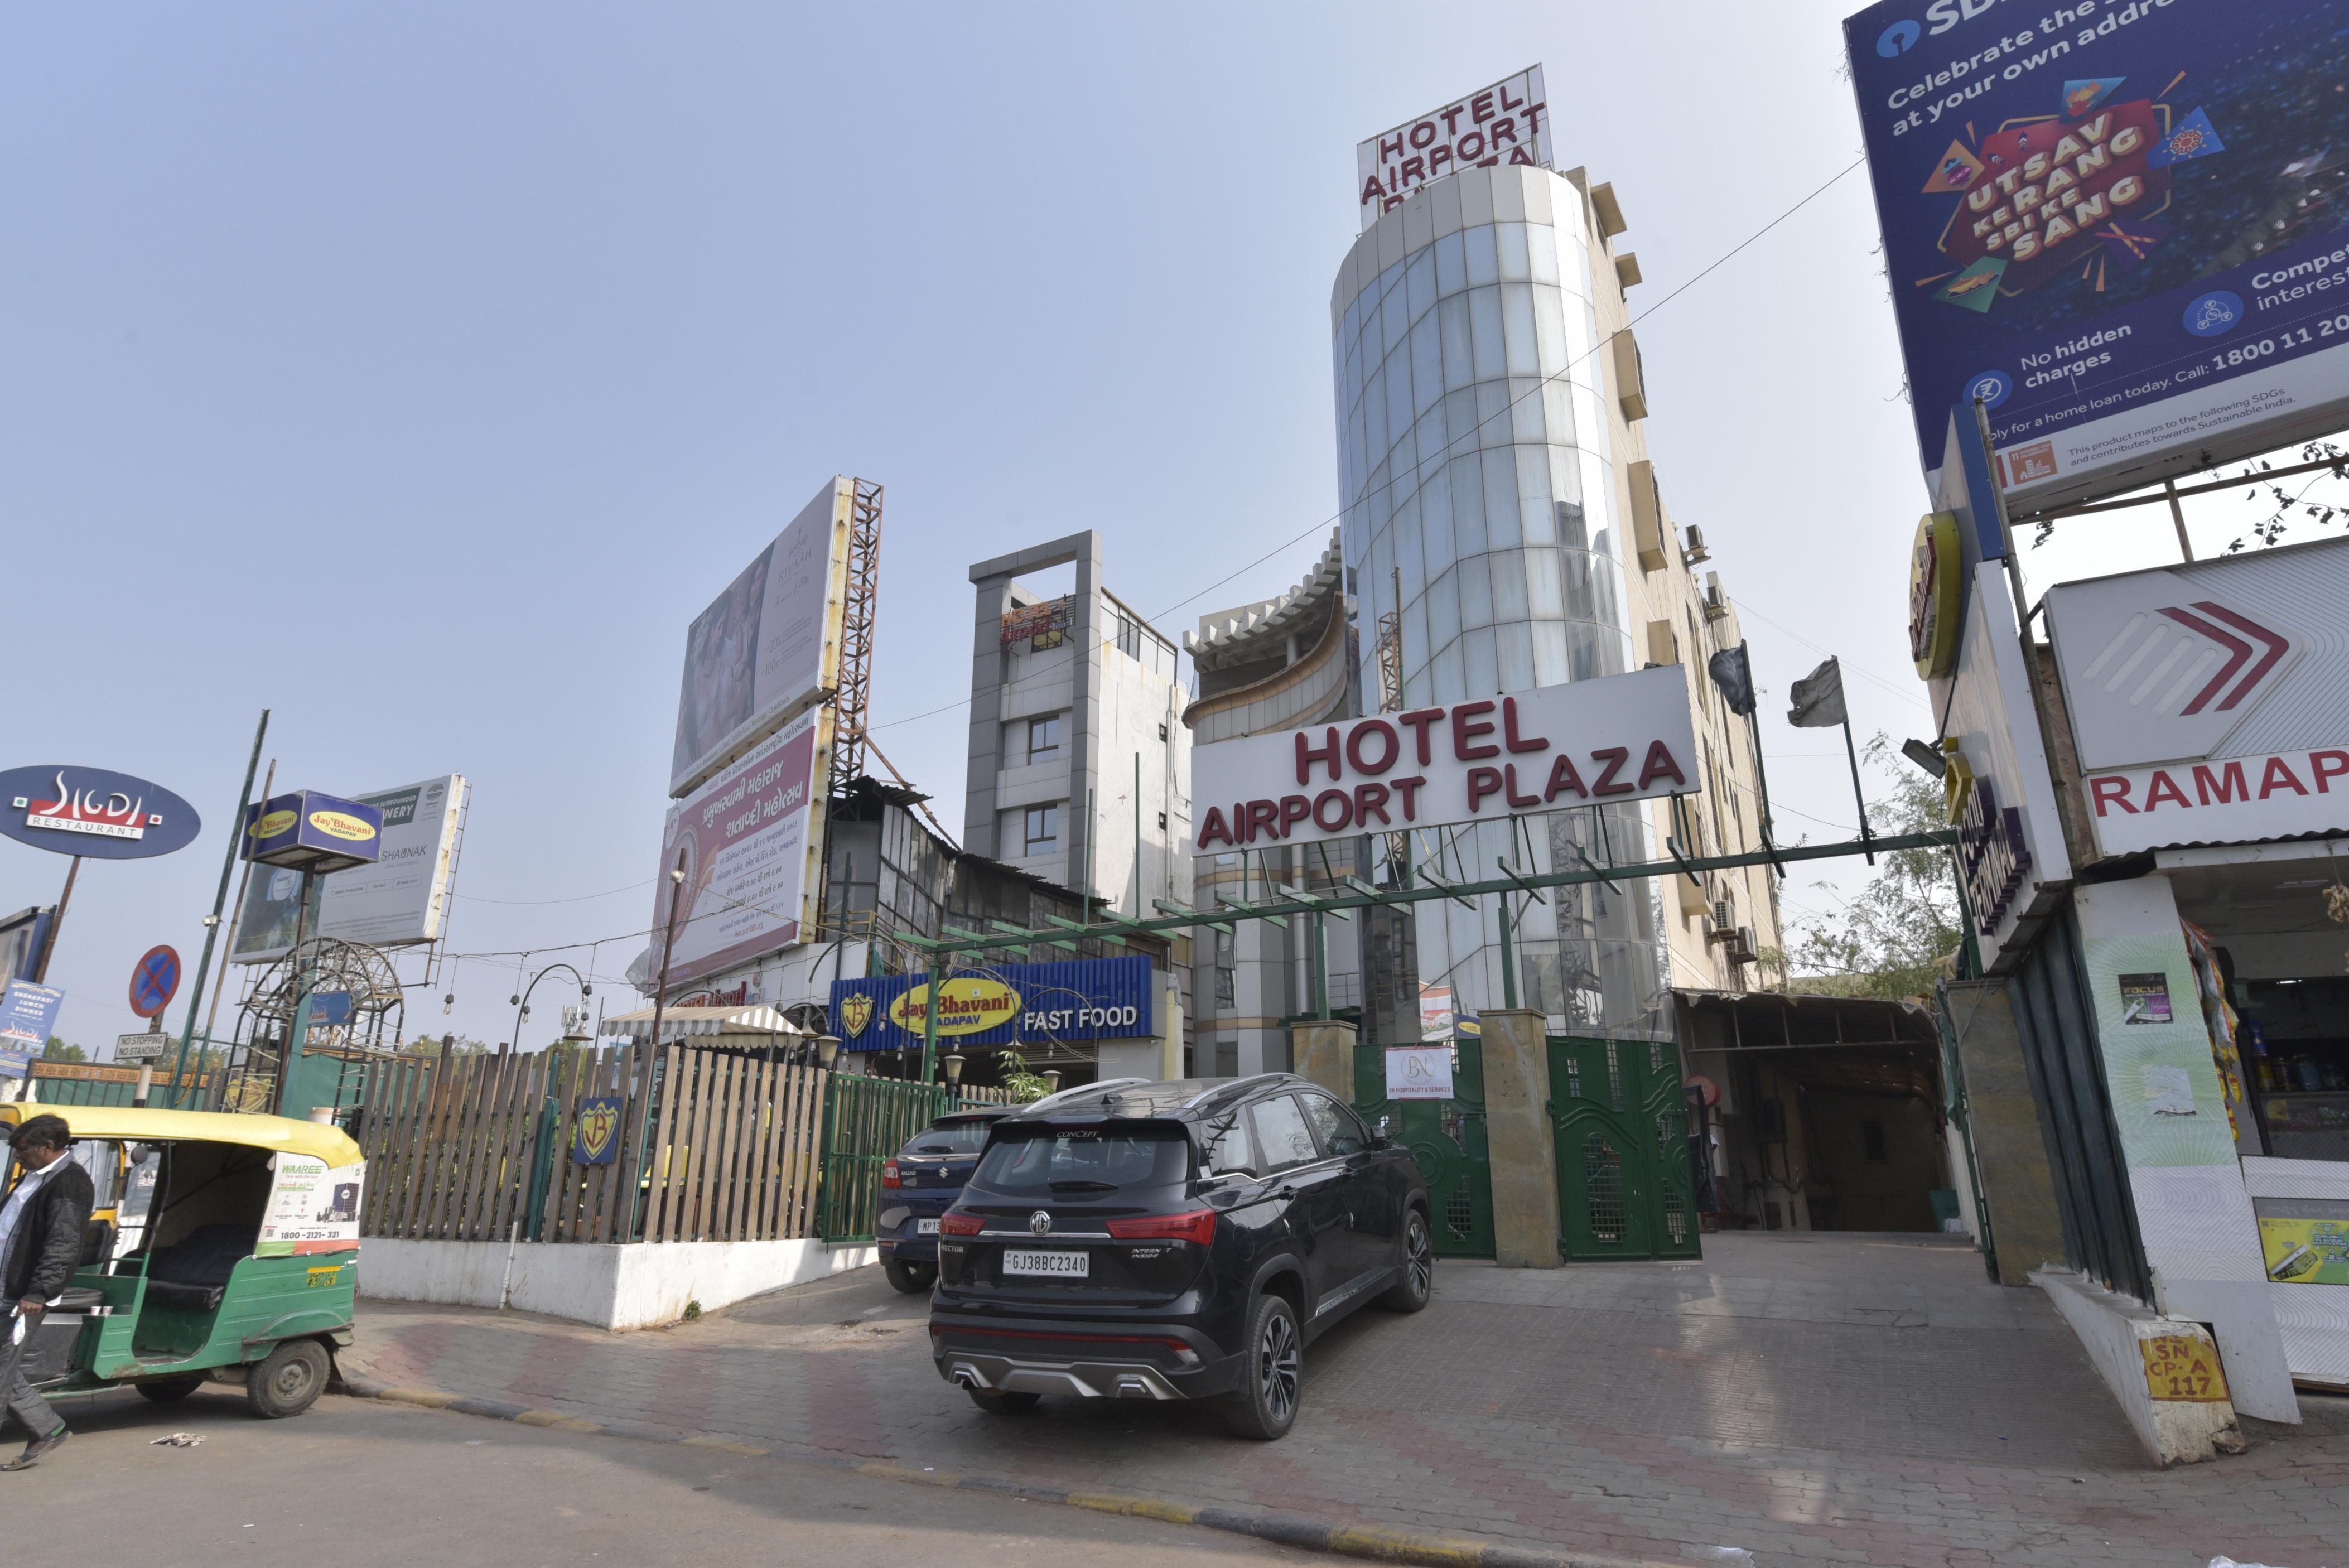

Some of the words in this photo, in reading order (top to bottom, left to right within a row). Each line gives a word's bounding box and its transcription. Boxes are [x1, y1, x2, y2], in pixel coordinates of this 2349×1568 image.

[1888, 30, 2033, 109] Celebrate
[2039, 0, 2095, 35] the
[1893, 110, 1923, 136] at
[1928, 73, 1996, 123] your
[2003, 39, 2070, 80] own
[1380, 86, 1523, 164] HOTEL
[1361, 102, 1545, 205] AIRPORT
[1968, 113, 2114, 213] UTSAV
[1973, 205, 2012, 238] KE
[2013, 126, 2146, 215] RANG
[1986, 213, 2036, 251] SBI
[2041, 187, 2082, 221] KE
[2013, 176, 2145, 262] SANG
[2020, 353, 2051, 370] No
[2055, 325, 2132, 359] hidden
[2011, 421, 2031, 433] for
[2046, 404, 2087, 423] home
[2090, 393, 2122, 409] loan
[2124, 378, 2172, 398] today.
[2175, 365, 2210, 383] Call:
[2212, 339, 2275, 370] 1800
[2280, 327, 2312, 348] 11
[2318, 314, 2349, 337] 20
[2025, 350, 2112, 388] charges
[2068, 446, 2090, 456] This
[2092, 433, 2133, 451] product
[2134, 425, 2164, 438] maps
[2165, 420, 2177, 428] to
[2179, 414, 2197, 424] the
[2200, 399, 2250, 418] following
[2251, 388, 2285, 403] SDGs
[2071, 456, 2089, 466] and
[2091, 438, 2150, 460] contributes
[2153, 426, 2196, 442] towards
[2197, 406, 2263, 430] Sustainable
[2264, 397, 2297, 410] India.
[1001, 601, 1052, 626] HOTEL
[1000, 616, 1052, 645] Airport
[1295, 697, 1550, 786] HOTEL
[702, 777, 745, 828] પ્રમુખસ્વામી
[747, 760, 783, 795] મહારાજ
[1198, 775, 1426, 850] AIRPORT
[1467, 740, 1686, 813] PLAZA
[2089, 750, 2349, 817] RAMAP
[39, 770, 142, 826] SIGDI
[379, 795, 416, 807] SURROUNDED
[726, 799, 760, 838] શતાબ્દી
[764, 780, 803, 818] મહોત્સવ
[33, 817, 137, 837] RESTAURANT
[314, 815, 330, 826] Jay
[330, 827, 356, 837] VADAPAV
[382, 845, 427, 861] SHAUNAK
[13, 991, 54, 1003] BREAKFAST
[20, 1000, 44, 1009] LUNCH
[15, 1006, 44, 1016] DINNER
[898, 1002, 927, 1019] Jay
[937, 1015, 981, 1026] ADAPAV
[1025, 1010, 1073, 1031] FAST
[1079, 1007, 1137, 1027] FOOD
[121, 1037, 131, 1045] NO
[132, 1036, 163, 1044] STOPPING
[129, 1046, 161, 1055] STANDING
[1406, 1056, 1433, 1078] BN
[282, 1165, 324, 1174] WAAREE
[1032, 1213, 1050, 1233] MG
[941, 1244, 964, 1253] HECTOR
[1013, 1254, 1086, 1272] GJ38BC2340
[2155, 1344, 2189, 1360] SN
[2169, 1376, 2211, 1395] 117
